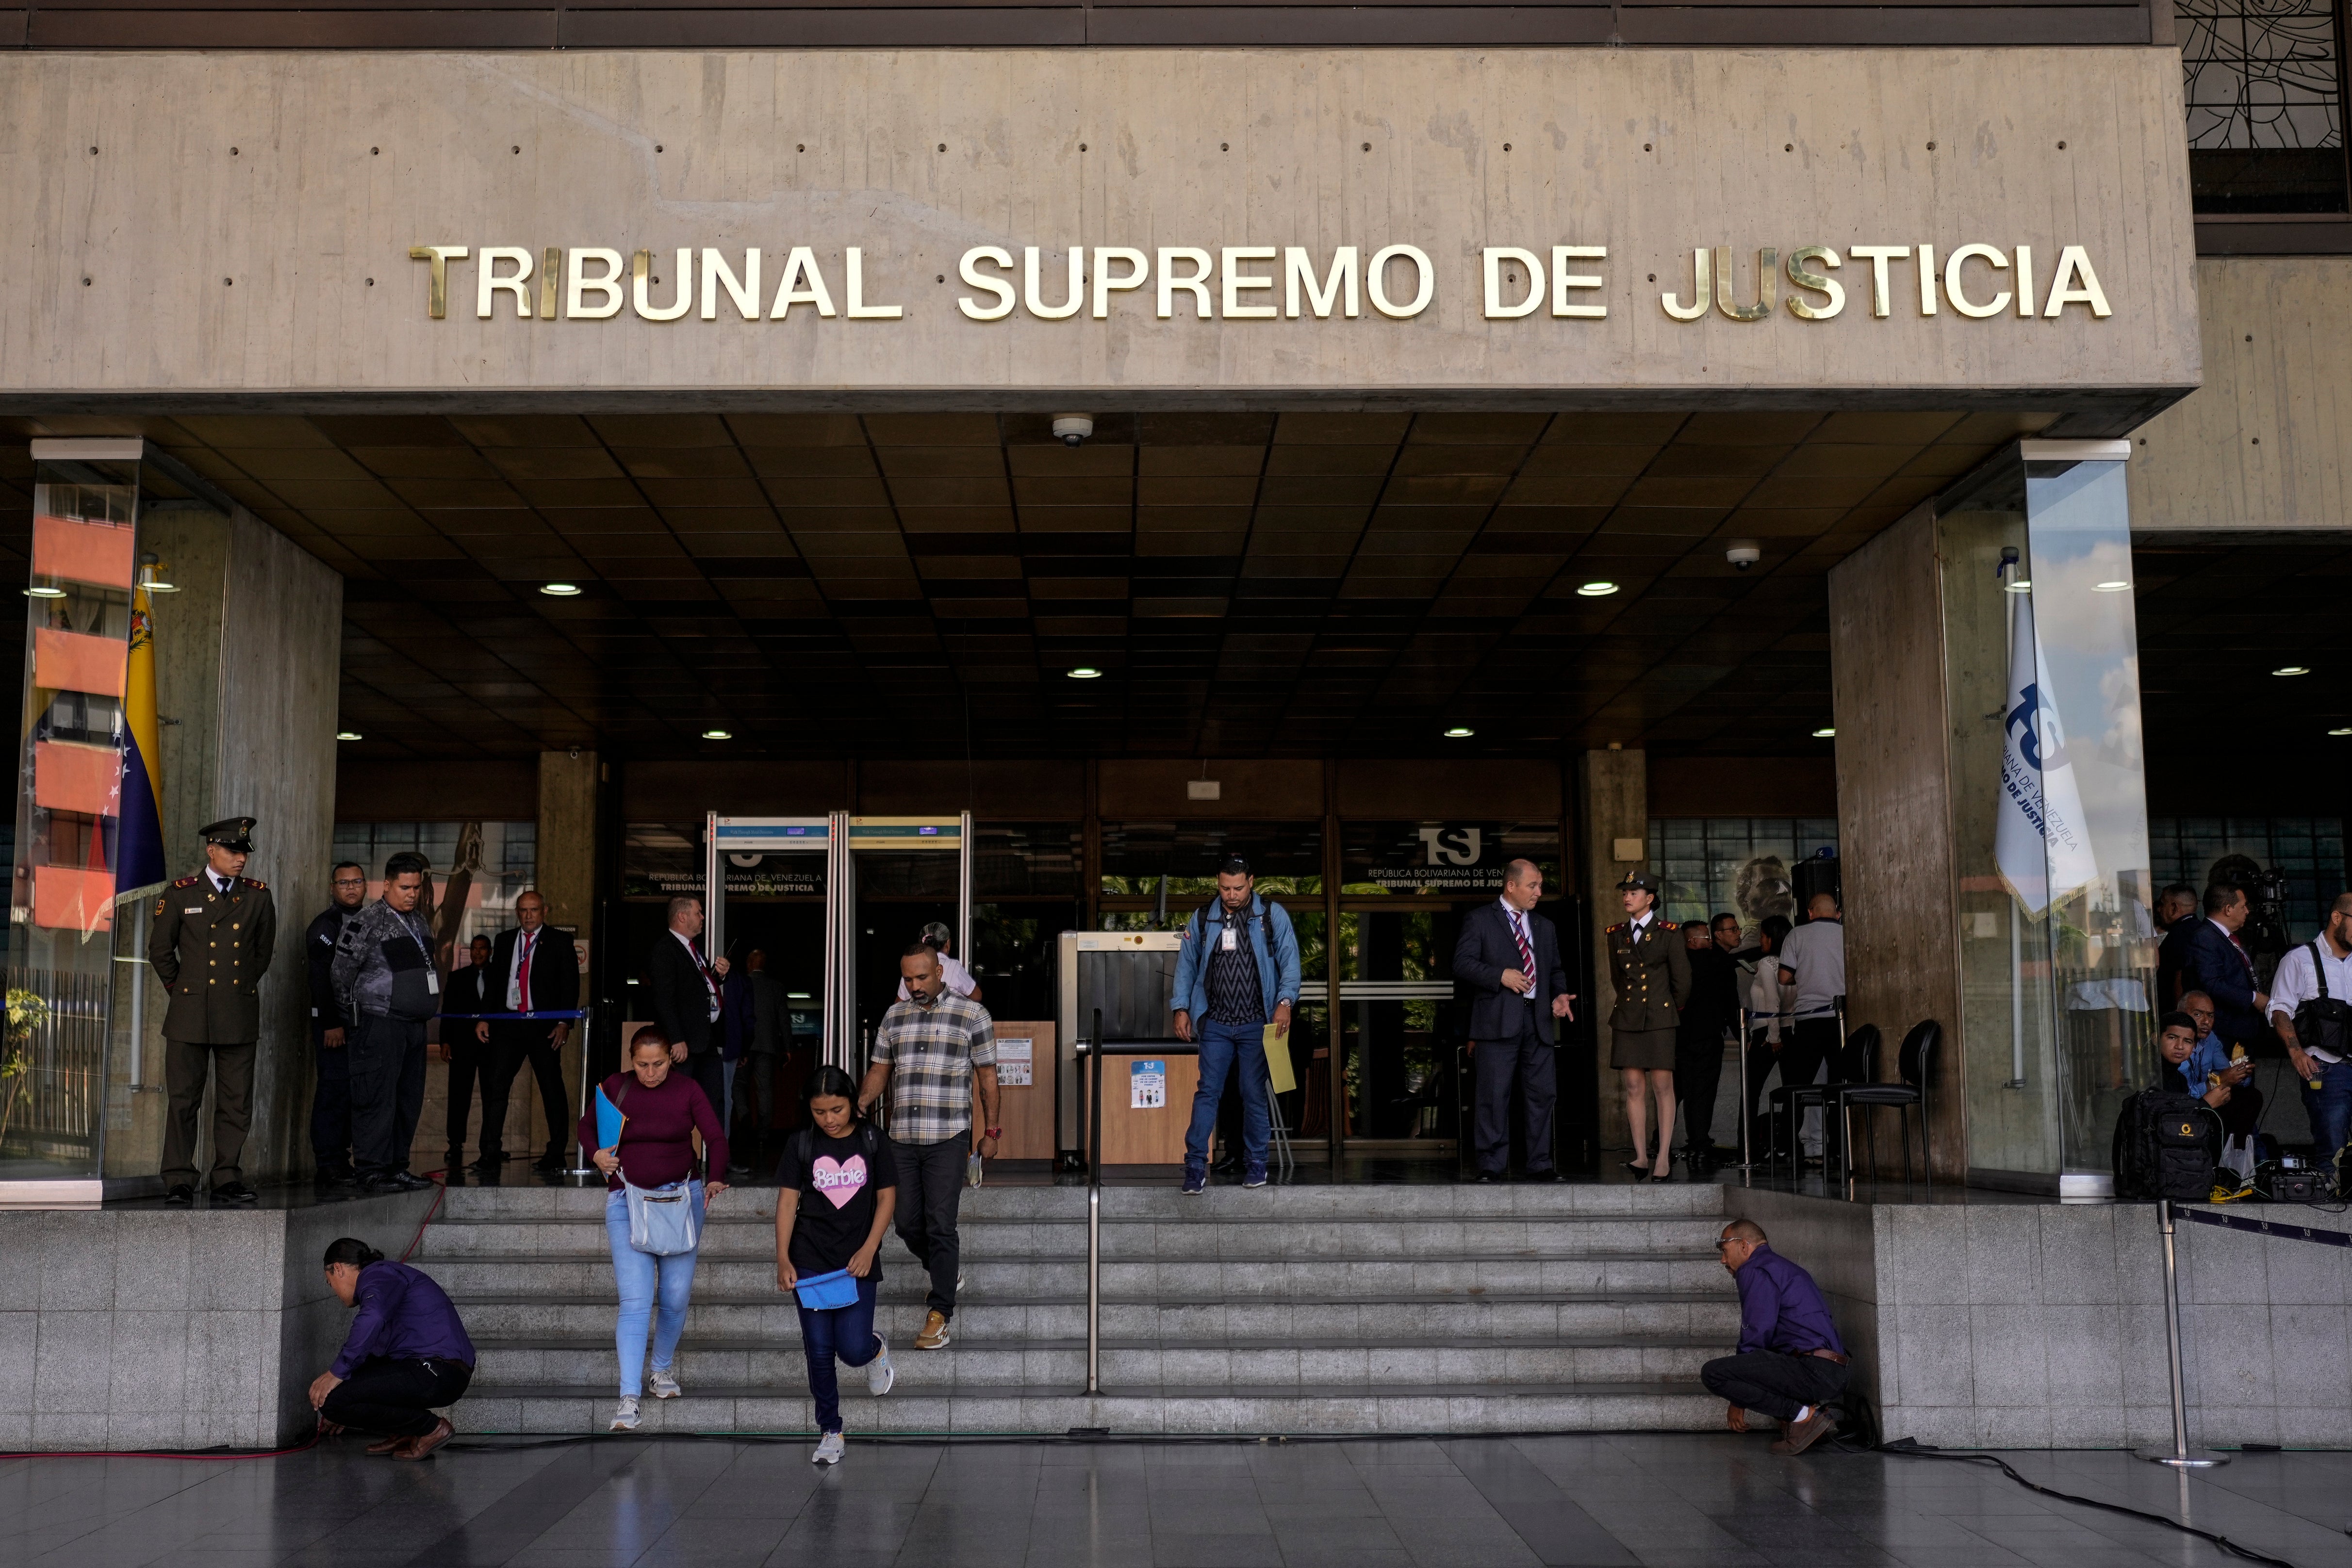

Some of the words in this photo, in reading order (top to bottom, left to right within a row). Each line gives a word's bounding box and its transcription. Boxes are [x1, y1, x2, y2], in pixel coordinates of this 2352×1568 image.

[408, 246, 903, 322] TRIBUNAL
[957, 244, 1434, 322] SUPREMO
[1482, 245, 1608, 321] DE
[1661, 243, 2113, 322] JUSTICIA
[2007, 782, 2022, 799] DE
[2017, 799, 2059, 848] JUSTICIA
[2019, 776, 2035, 792] DE
[2031, 790, 2078, 851] VENEZUELA
[1368, 868, 1412, 877] REPÚBLICA
[320, 934, 332, 946] SSST
[813, 1168, 865, 1188] Barbie
